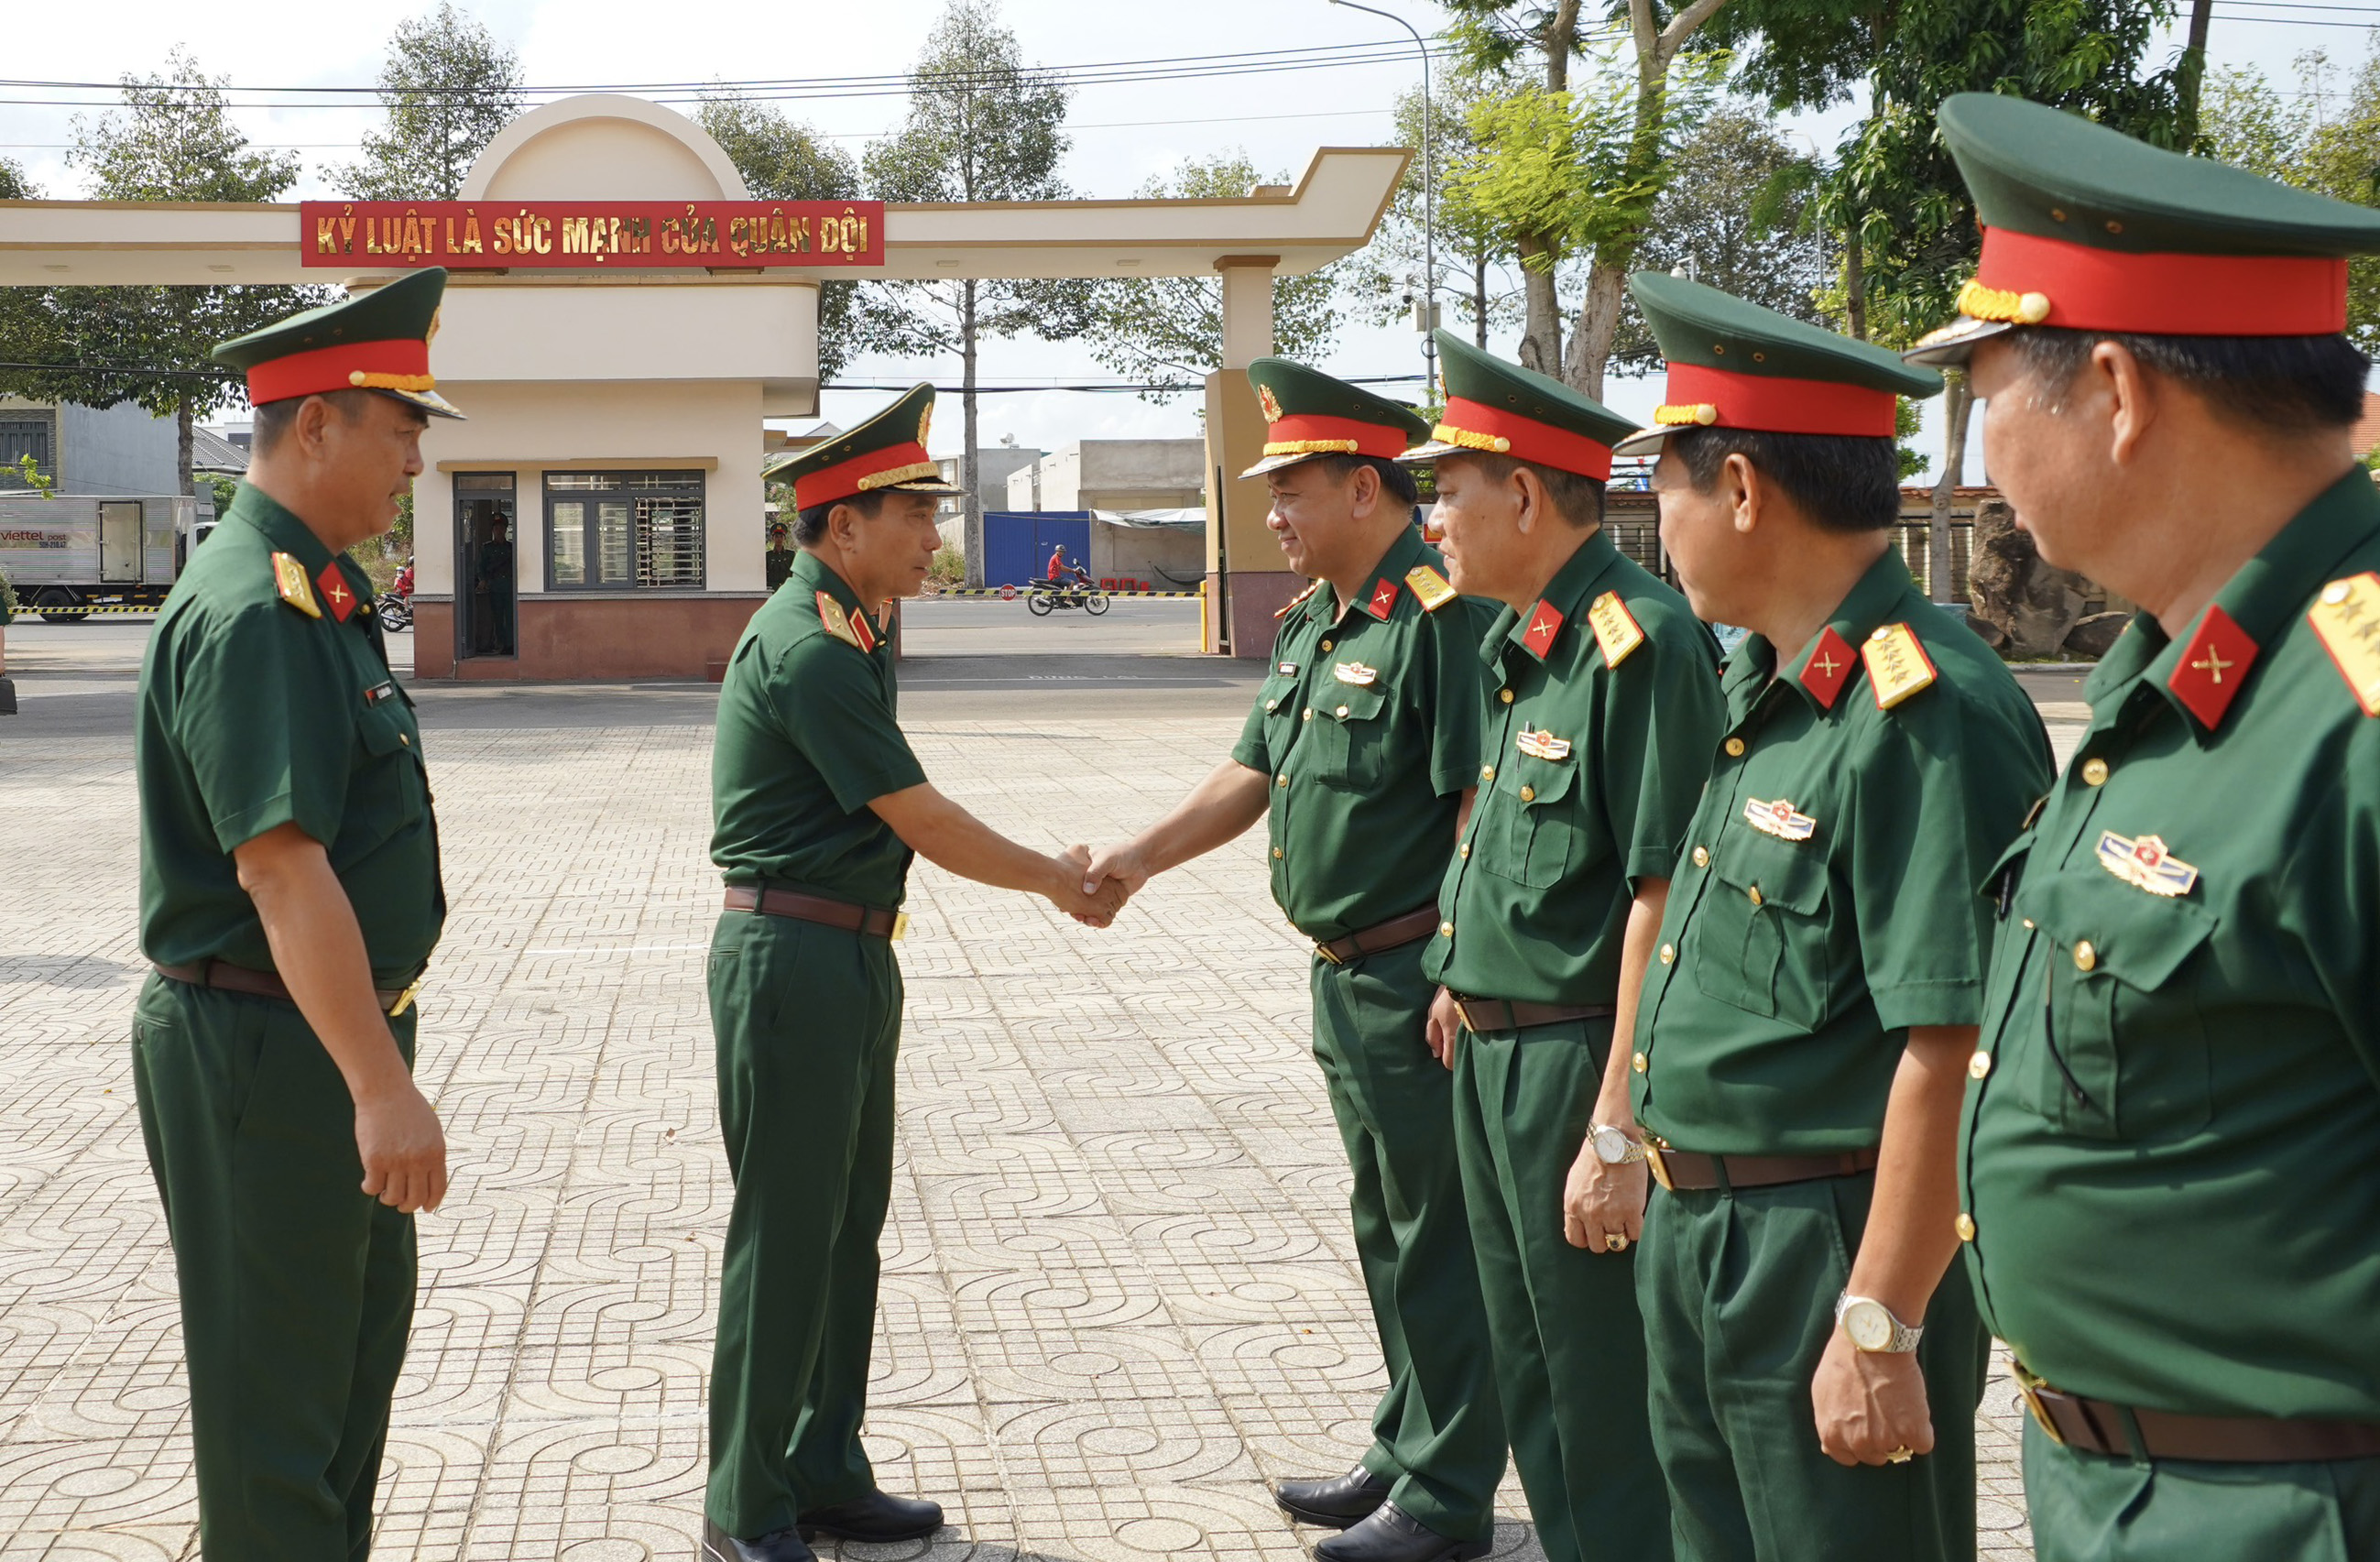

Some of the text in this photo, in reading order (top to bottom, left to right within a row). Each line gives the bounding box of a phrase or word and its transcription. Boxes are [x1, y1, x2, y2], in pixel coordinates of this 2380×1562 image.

[317, 203, 868, 262] KỶ LUẬT LÀ SỨC MẠNH CỦA QUÂN ĐỘI
[0, 530, 44, 541] viettel
[1000, 589, 1015, 597] STOP
